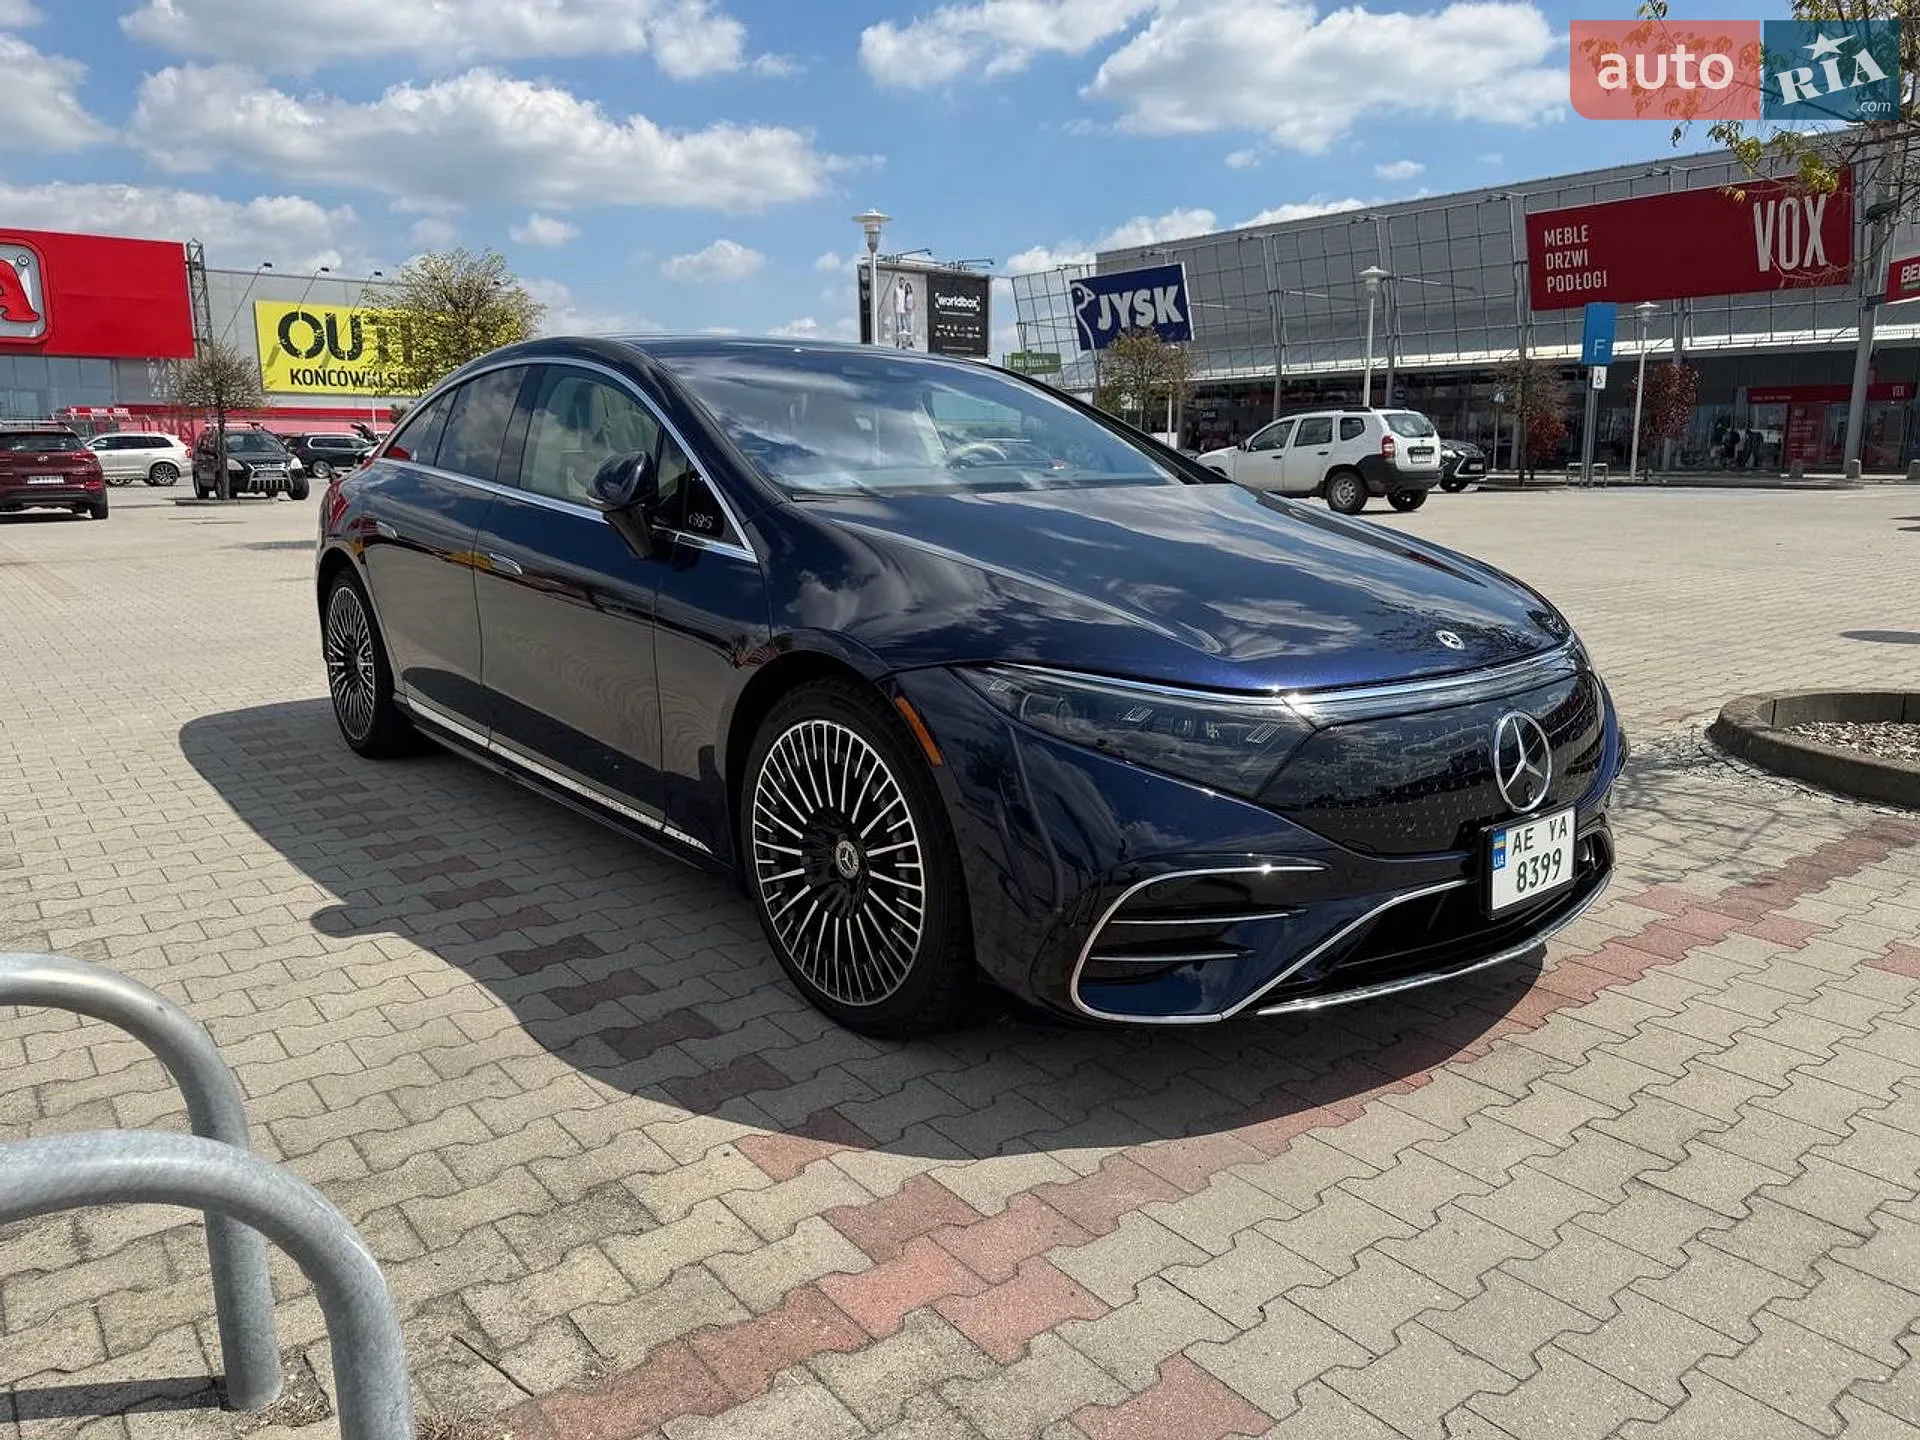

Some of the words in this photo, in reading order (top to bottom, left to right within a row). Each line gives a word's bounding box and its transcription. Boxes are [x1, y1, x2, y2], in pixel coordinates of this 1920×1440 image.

[1544, 224, 1589, 248] MEBLE
[1753, 194, 1828, 273] VOX
[1545, 248, 1589, 271] DRZWI
[1547, 270, 1608, 294] PODŁOGI
[1097, 285, 1184, 331] JYSK
[1594, 338, 1606, 357] F
[1512, 826, 1535, 856] AE
[1549, 816, 1568, 841] YA
[1516, 847, 1562, 893] 8399
